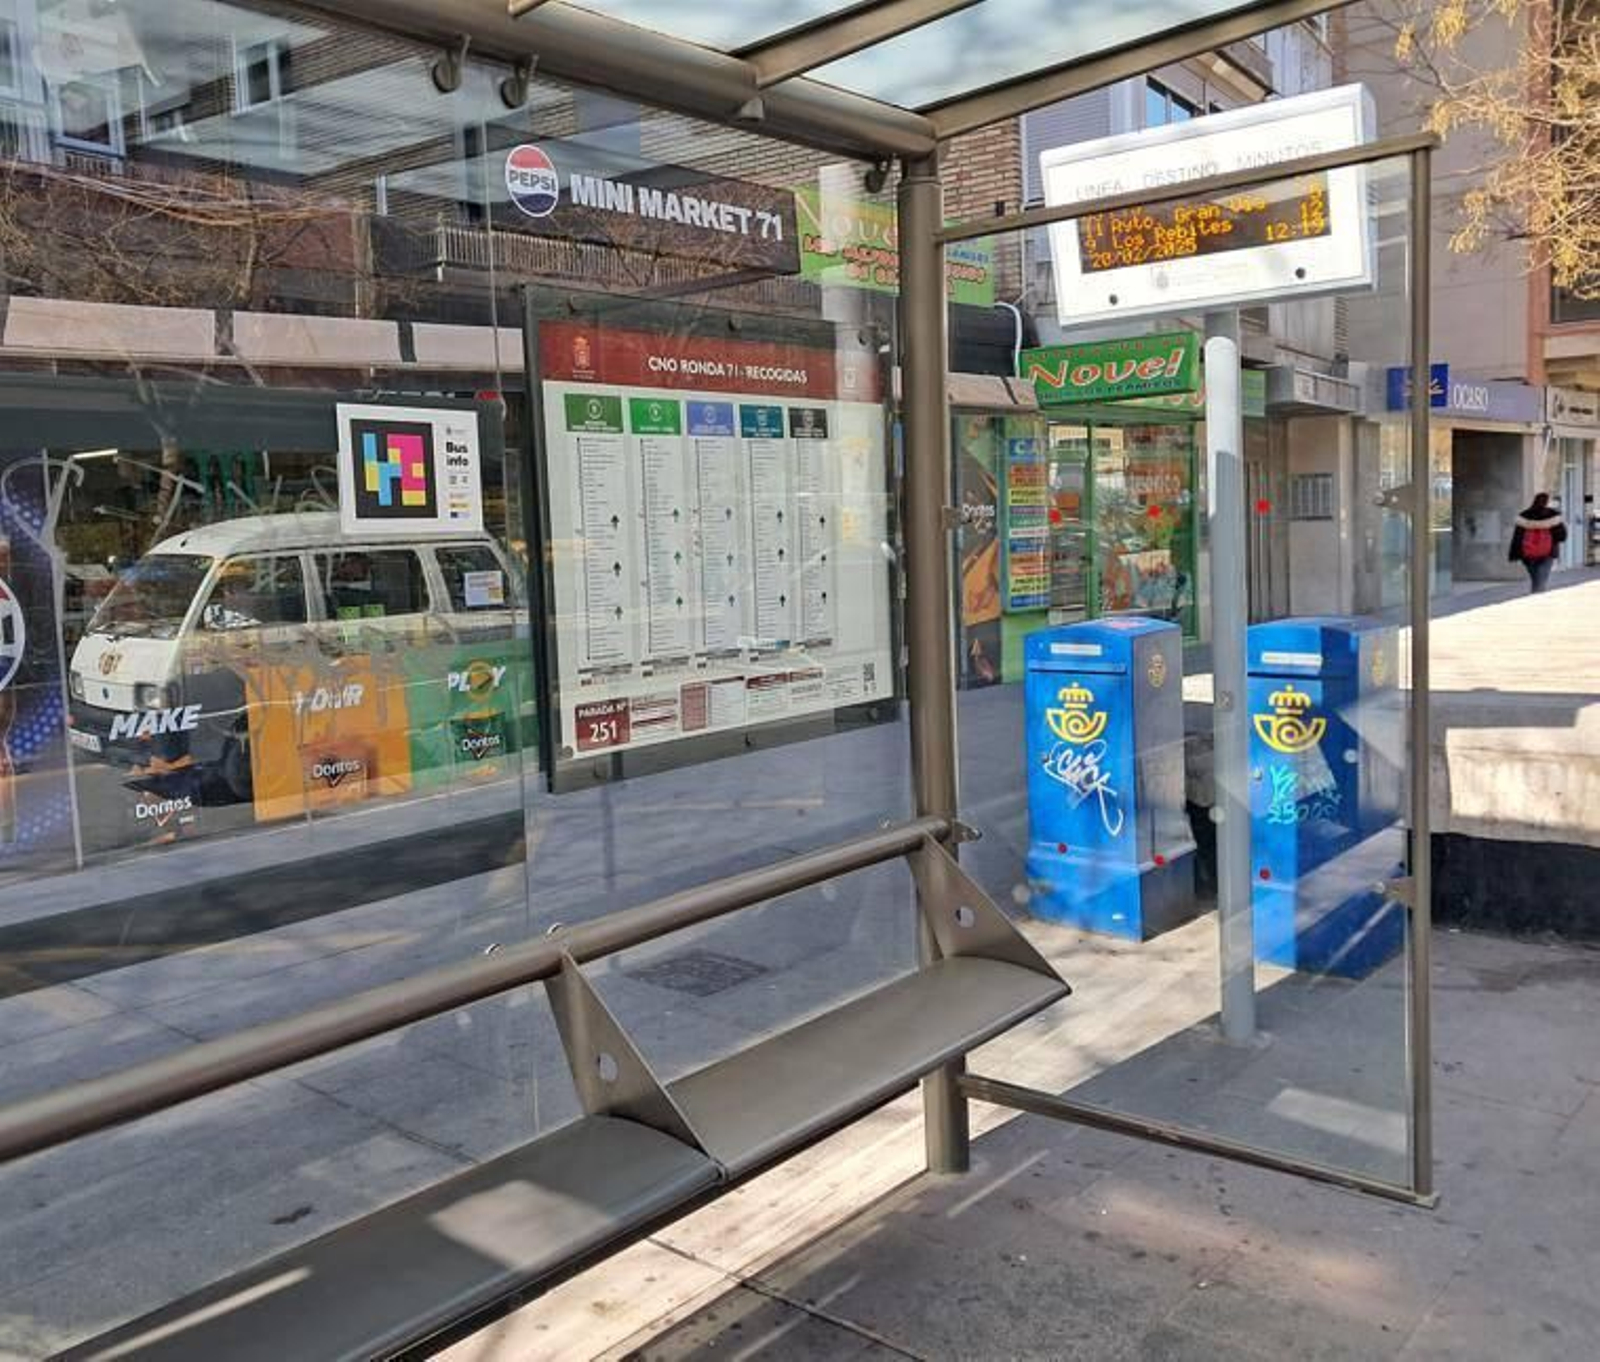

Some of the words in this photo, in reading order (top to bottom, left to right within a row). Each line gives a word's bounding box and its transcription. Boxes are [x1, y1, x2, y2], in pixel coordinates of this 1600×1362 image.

[509, 168, 557, 192] PEPSI
[570, 173, 634, 214] MINI
[637, 187, 754, 235] MARKET
[755, 209, 783, 241] 71
[1173, 205, 1222, 224] Gran
[648, 355, 679, 374] CNO
[680, 358, 725, 377] RONDA
[746, 365, 808, 385] RECOGIDAS
[1028, 346, 1186, 388] Novel
[1452, 384, 1489, 412] OCASO
[446, 441, 469, 454] Bus
[446, 455, 469, 467] info
[109, 702, 202, 741] MAKE
[578, 705, 616, 720] PARADA
[589, 719, 617, 742] 251
[462, 734, 500, 752] Doritos
[313, 760, 362, 779] Doritos
[135, 795, 192, 819] Doritos
